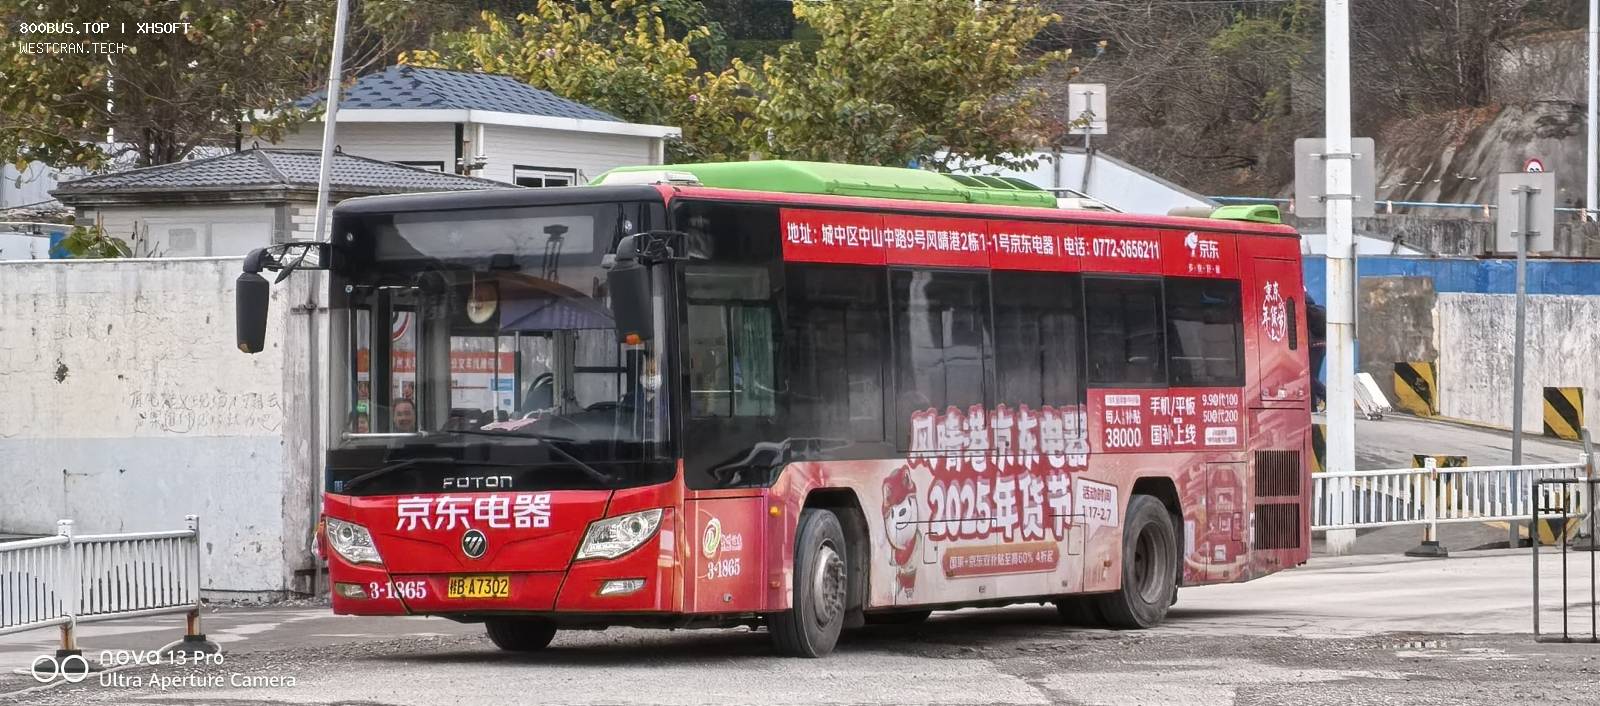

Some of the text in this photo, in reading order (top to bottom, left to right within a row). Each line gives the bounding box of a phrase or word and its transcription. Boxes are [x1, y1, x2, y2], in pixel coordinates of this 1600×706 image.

[1199, 240, 1220, 259] 京东
[1150, 396, 1196, 416] 手机/平板
[1105, 427, 1142, 448] 38000
[442, 475, 513, 489] FOTON
[1082, 486, 1112, 503] 活动时间
[395, 493, 552, 531] 京东电器
[929, 470, 1073, 542] 2025年货节
[706, 557, 741, 580] 3-1865
[369, 581, 428, 600] 3-1865
